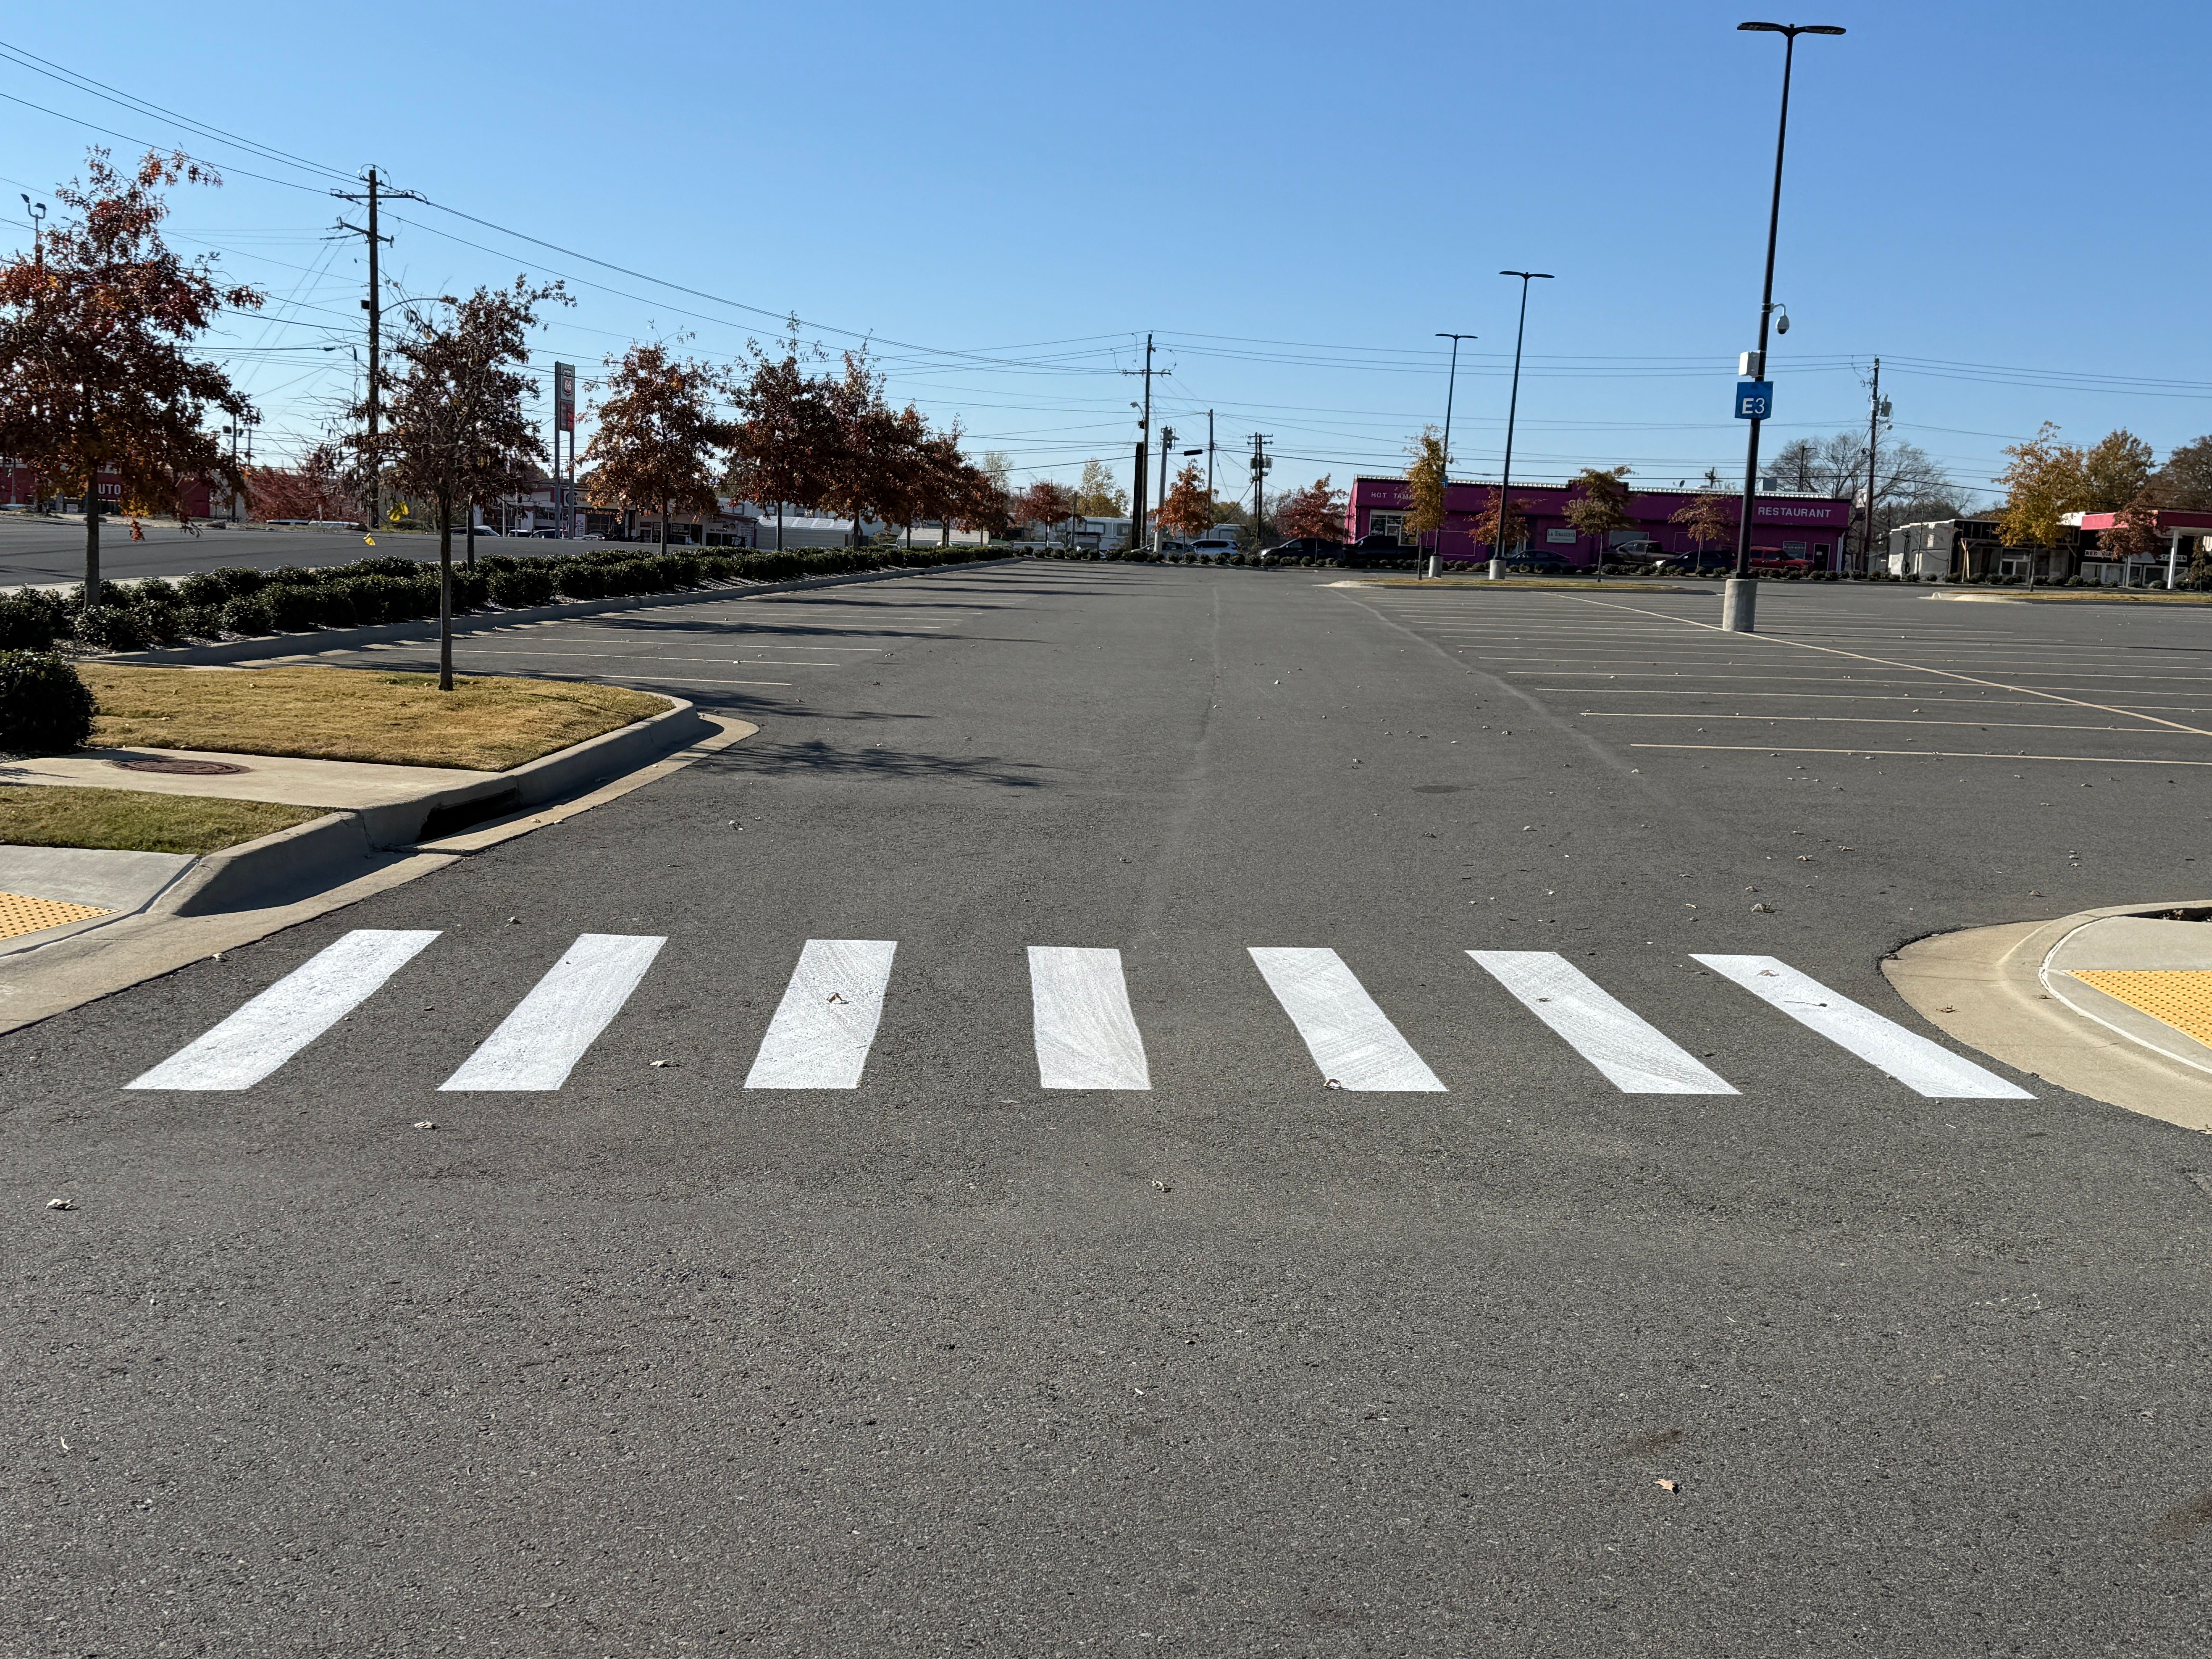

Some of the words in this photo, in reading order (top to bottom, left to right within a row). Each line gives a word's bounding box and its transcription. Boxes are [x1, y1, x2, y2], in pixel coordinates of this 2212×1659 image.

[1742, 398, 1765, 414] E3
[98, 483, 121, 495] UTO
[1758, 507, 1831, 518] RESTAURANT
